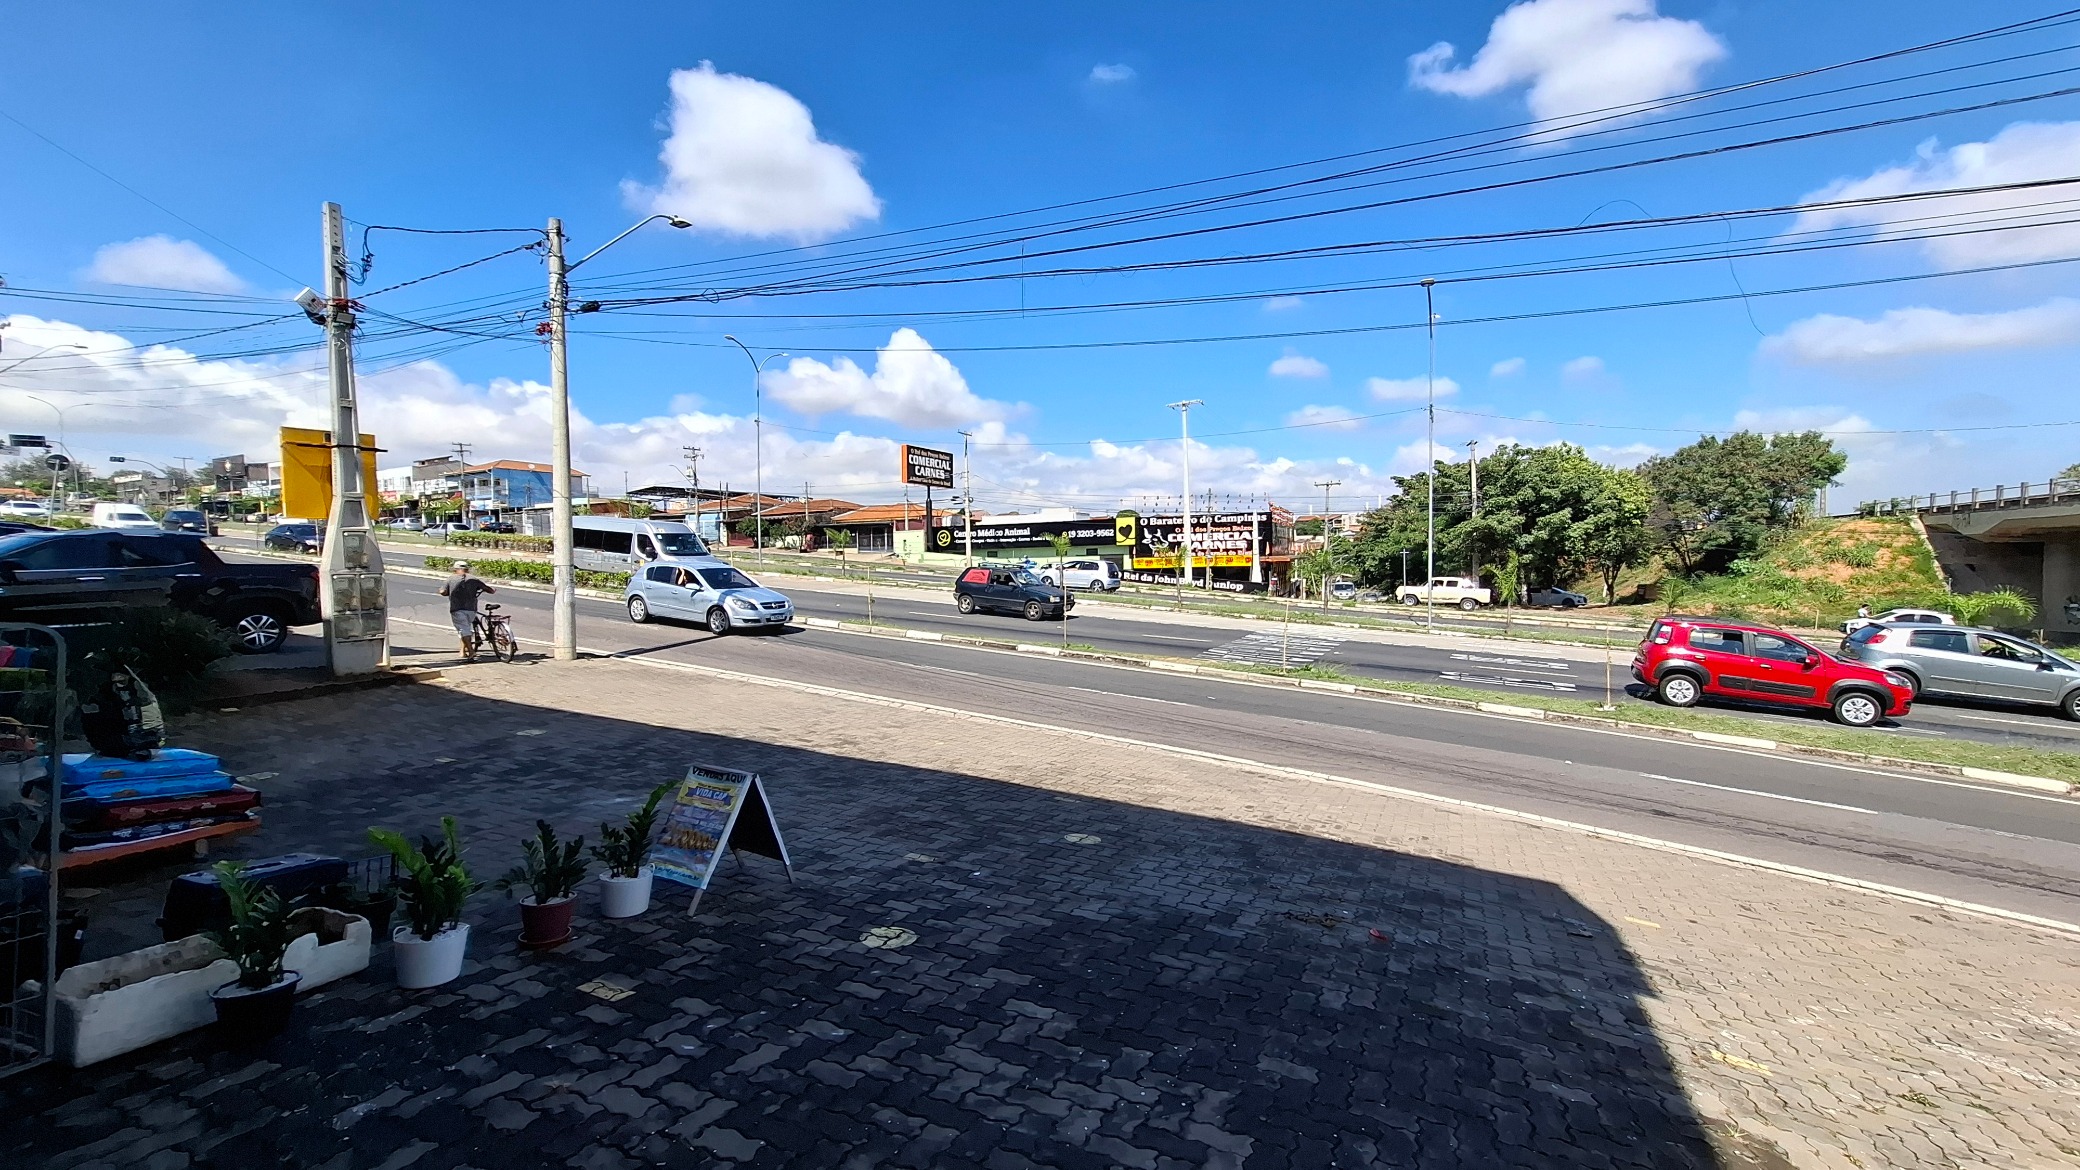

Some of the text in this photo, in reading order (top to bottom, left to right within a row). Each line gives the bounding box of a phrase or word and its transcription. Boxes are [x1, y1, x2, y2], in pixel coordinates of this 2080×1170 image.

[908, 454, 951, 470] COMERCIAL
[914, 466, 945, 480] CARNES
[1140, 518, 1148, 526] O
[1150, 517, 1198, 526] Barateo
[1199, 515, 1212, 524] de
[1214, 514, 1267, 524] Campins
[954, 527, 1030, 538] Cenro Médico Animal
[1068, 528, 1114, 538] 19 3203-9562
[1124, 572, 1140, 580] Rei
[1140, 574, 1153, 582] da
[1154, 574, 1176, 584] John
[1178, 578, 1203, 588] Byd
[696, 787, 712, 798] VIDA
